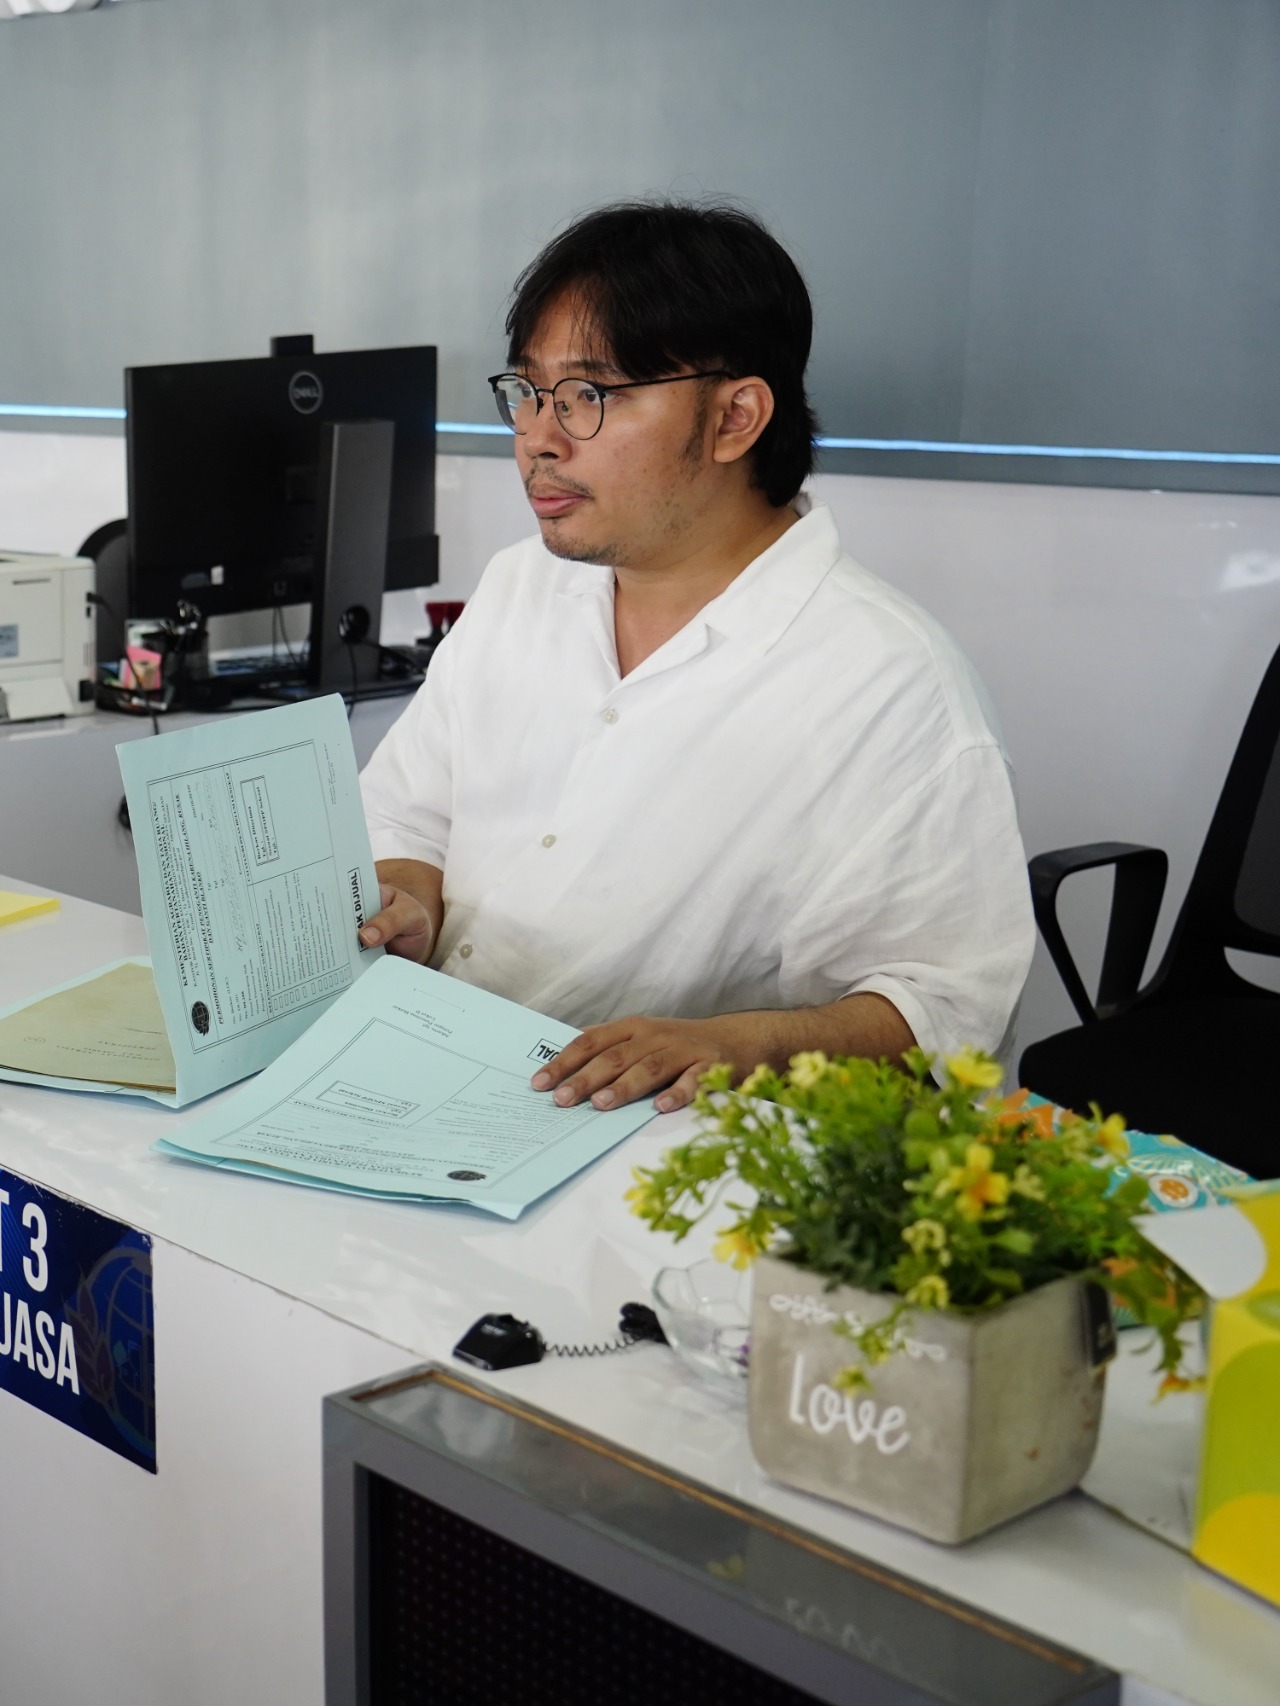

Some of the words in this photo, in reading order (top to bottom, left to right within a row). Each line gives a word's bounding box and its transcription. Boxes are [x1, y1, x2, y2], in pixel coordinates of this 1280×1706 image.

[174, 792, 183, 818] RUSAK
[159, 824, 171, 868] NASIONAL
[187, 850, 196, 882] KARENA
[164, 880, 174, 918] AGRARIA
[167, 870, 181, 929] PERTANAHAN
[196, 870, 205, 902] BLANKO
[350, 872, 362, 912] DIJUAL
[202, 902, 210, 927] GANTI
[172, 922, 187, 986] KEMENTERIAN
[178, 930, 187, 960] BADAN
[210, 971, 223, 1025] PERMOHONAN
[22, 1202, 48, 1292] 3
